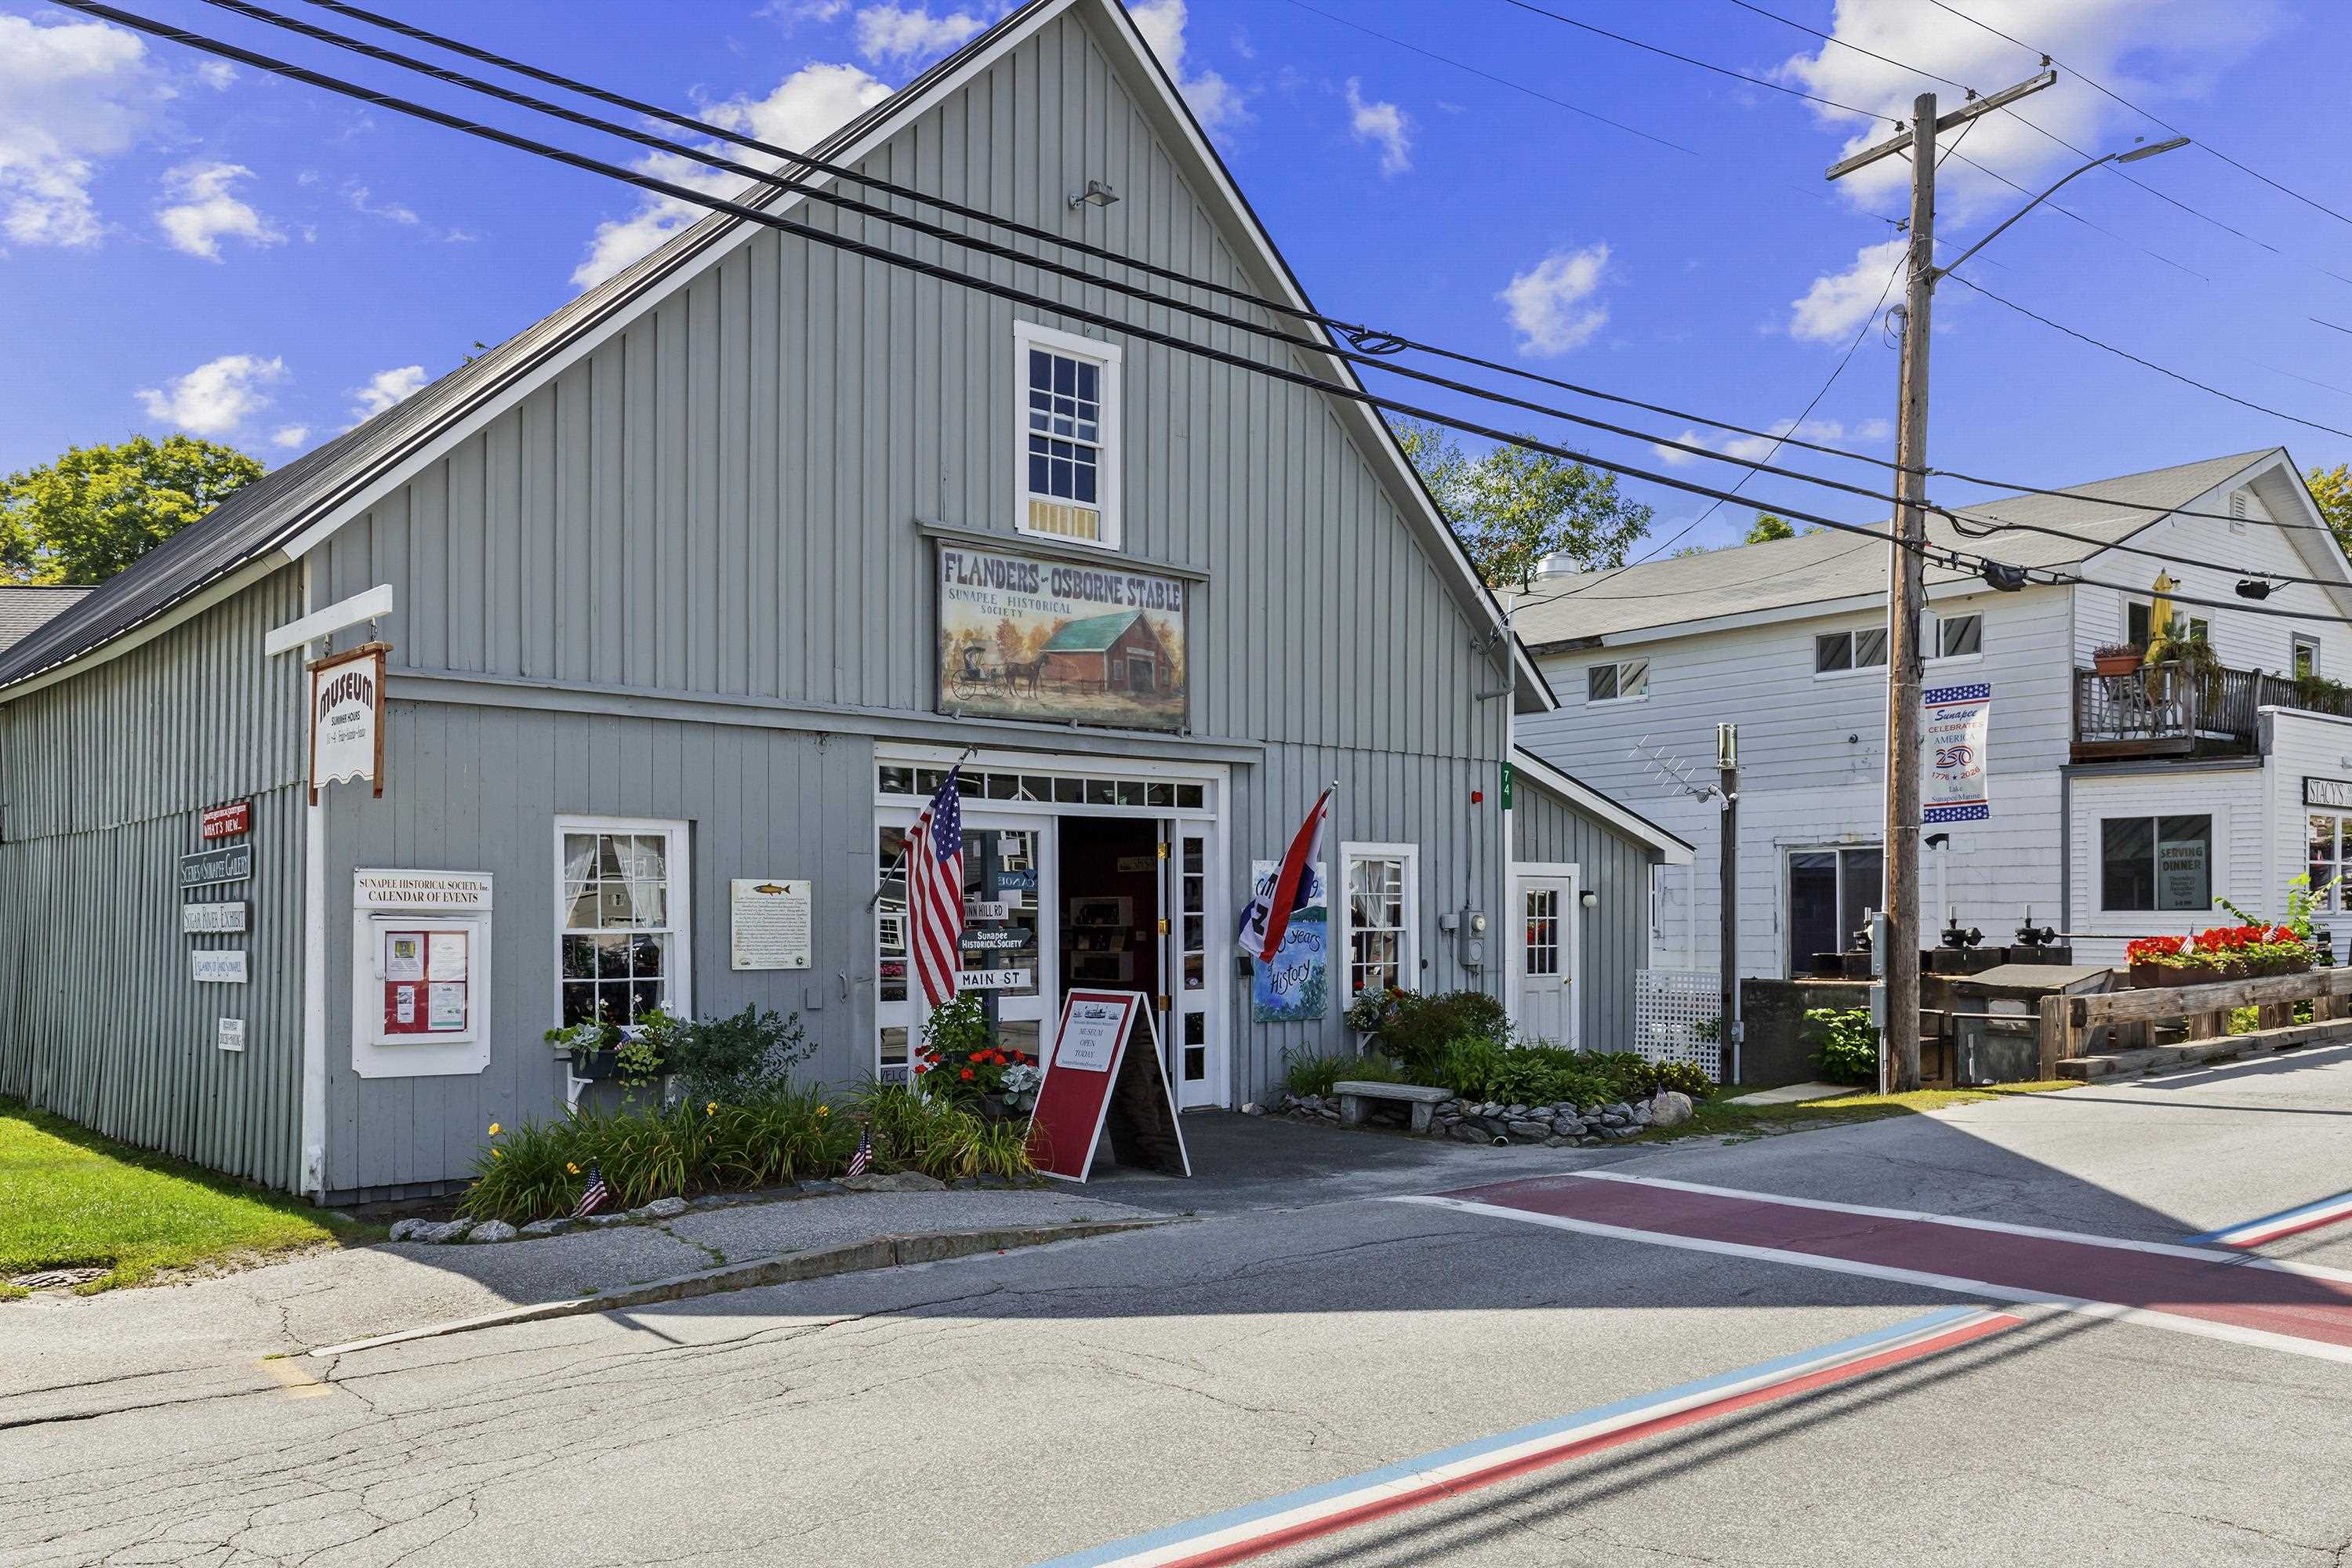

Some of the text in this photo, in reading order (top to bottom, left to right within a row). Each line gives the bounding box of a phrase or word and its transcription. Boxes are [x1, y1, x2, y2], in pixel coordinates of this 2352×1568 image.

[944, 552, 1181, 612] FLANDERS OSBORNE STABLE
[949, 588, 1073, 615] SUNAPEE HISTORICAL
[981, 604, 1024, 618] SOCIETY
[319, 672, 373, 724] MUSEUM
[331, 710, 361, 726] SUMMER HOURS
[1935, 709, 1977, 721] Sunapee
[1928, 721, 1984, 734] CELEBRATES
[1934, 734, 1976, 745] AMERICA
[1936, 746, 1974, 768] 250
[1931, 766, 1981, 781] 1776 2026
[1504, 770, 1510, 796] 74
[1948, 785, 1963, 793] Lake
[1957, 793, 1980, 801] Marine
[2310, 780, 2344, 805] STACY'S
[2160, 847, 2203, 858] SERVING
[225, 853, 248, 877] GALLERY
[2163, 859, 2202, 872] DINNER
[359, 878, 397, 888] SUNAPEE
[399, 879, 446, 889] HISTORICAL
[368, 891, 478, 903] CALENDAR OF EVENTS
[220, 904, 245, 928] EXHIBIT
[978, 905, 993, 917] HILL
[994, 904, 1004, 916] RD
[977, 931, 1008, 942] Sunapee
[962, 971, 1020, 986] MAIN ST
[1074, 1049, 1095, 1058] TODAY
